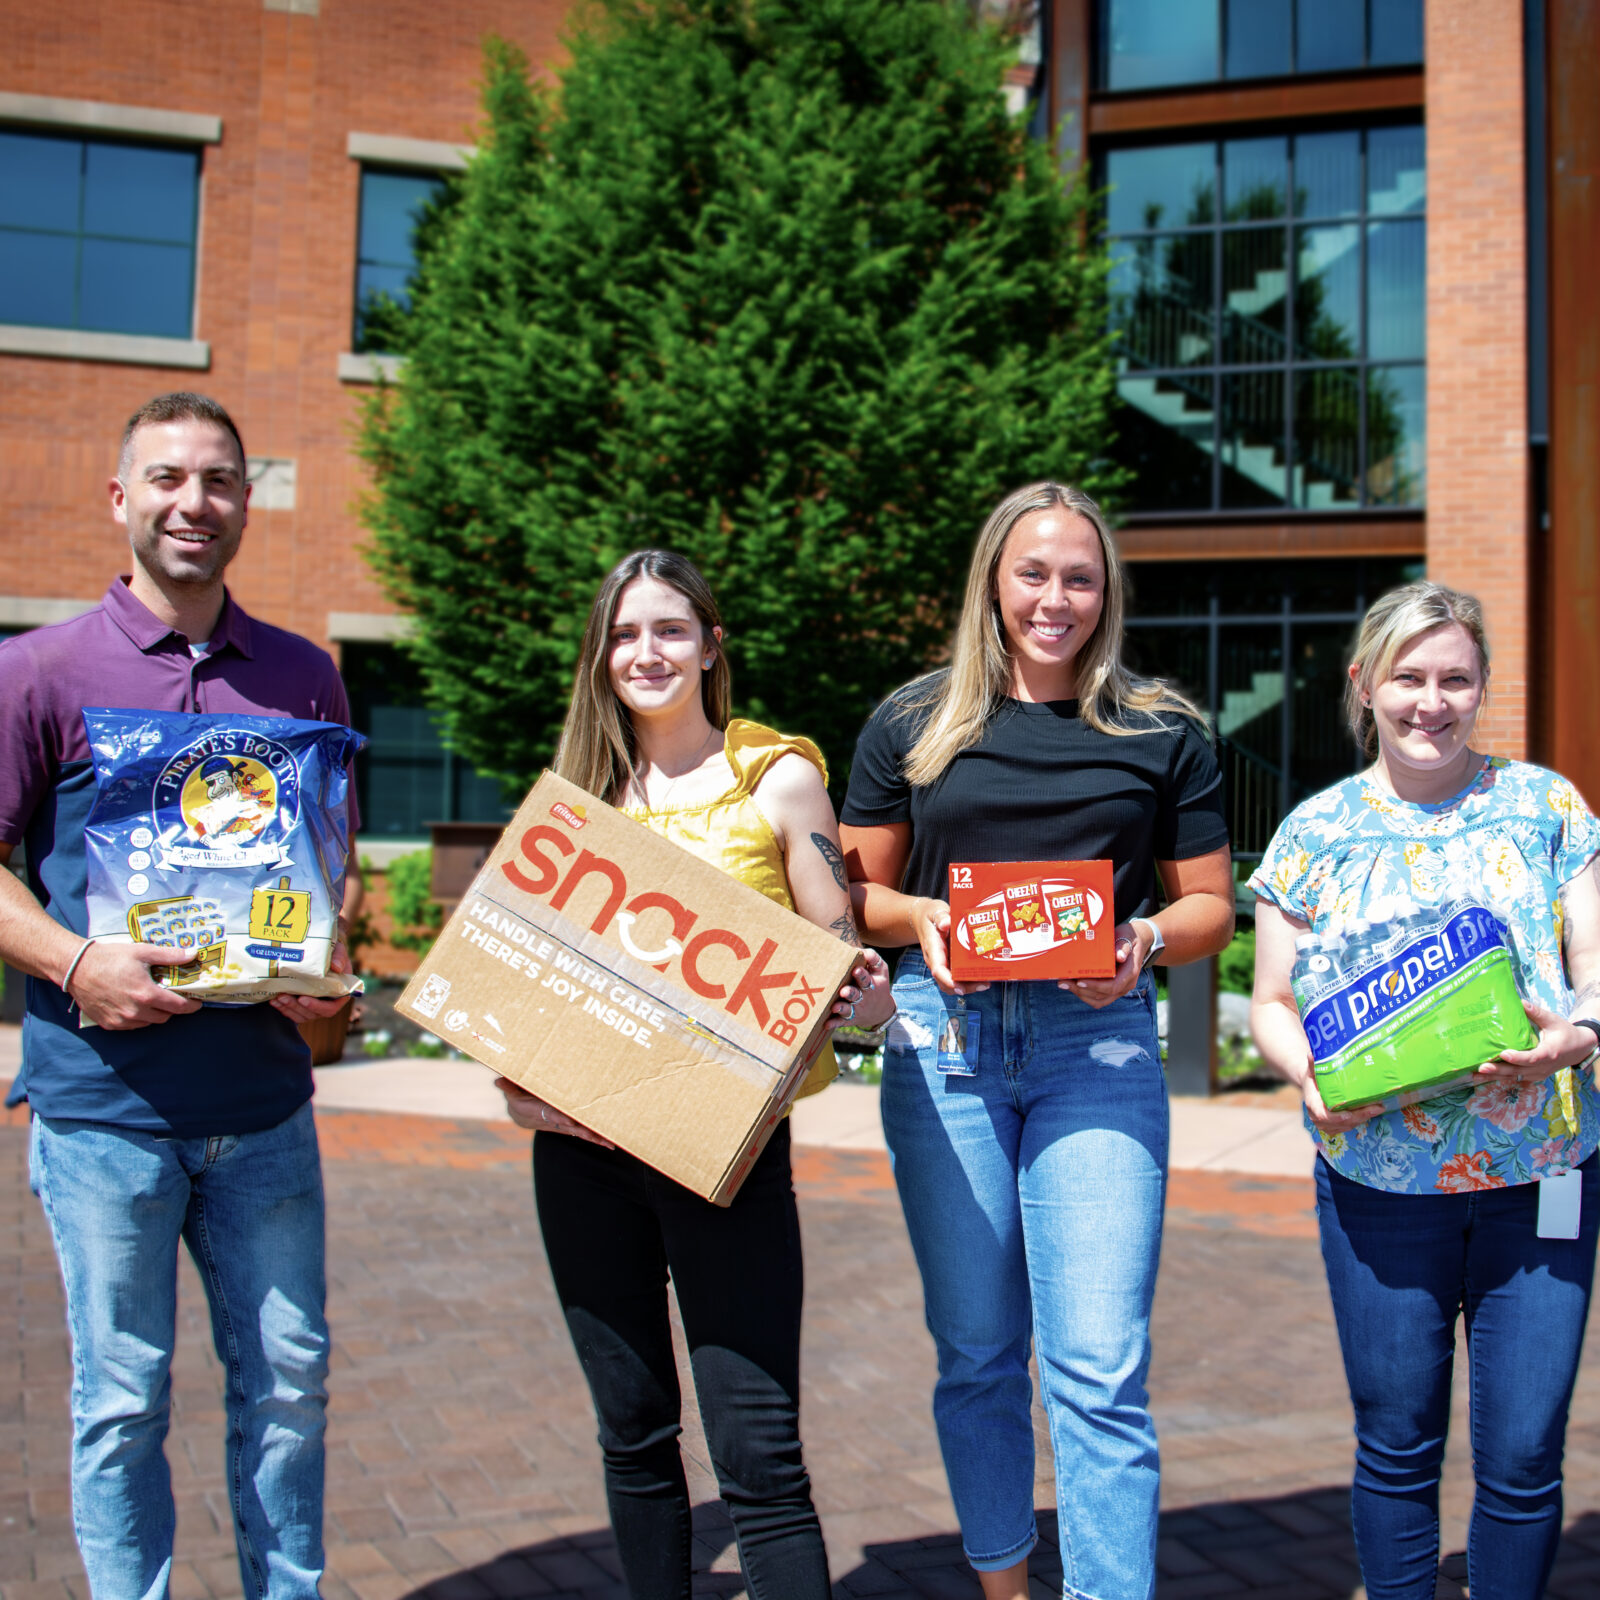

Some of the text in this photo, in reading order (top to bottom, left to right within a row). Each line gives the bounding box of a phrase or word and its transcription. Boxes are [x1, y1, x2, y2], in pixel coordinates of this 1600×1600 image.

[161, 735, 296, 789] PIRATE'S BOOTY
[952, 867, 972, 882] 12
[264, 894, 295, 928] 12
[264, 927, 290, 938] PACK
[501, 824, 797, 1031] snack
[461, 921, 652, 1049] THERE'S JOY INSIDE.
[469, 902, 667, 1033] HANDLE WITH CARE,
[1348, 932, 1454, 1030] propel
[1363, 993, 1408, 1025] FITNESS
[1418, 961, 1456, 989] WATER
[768, 975, 825, 1047] BOX
